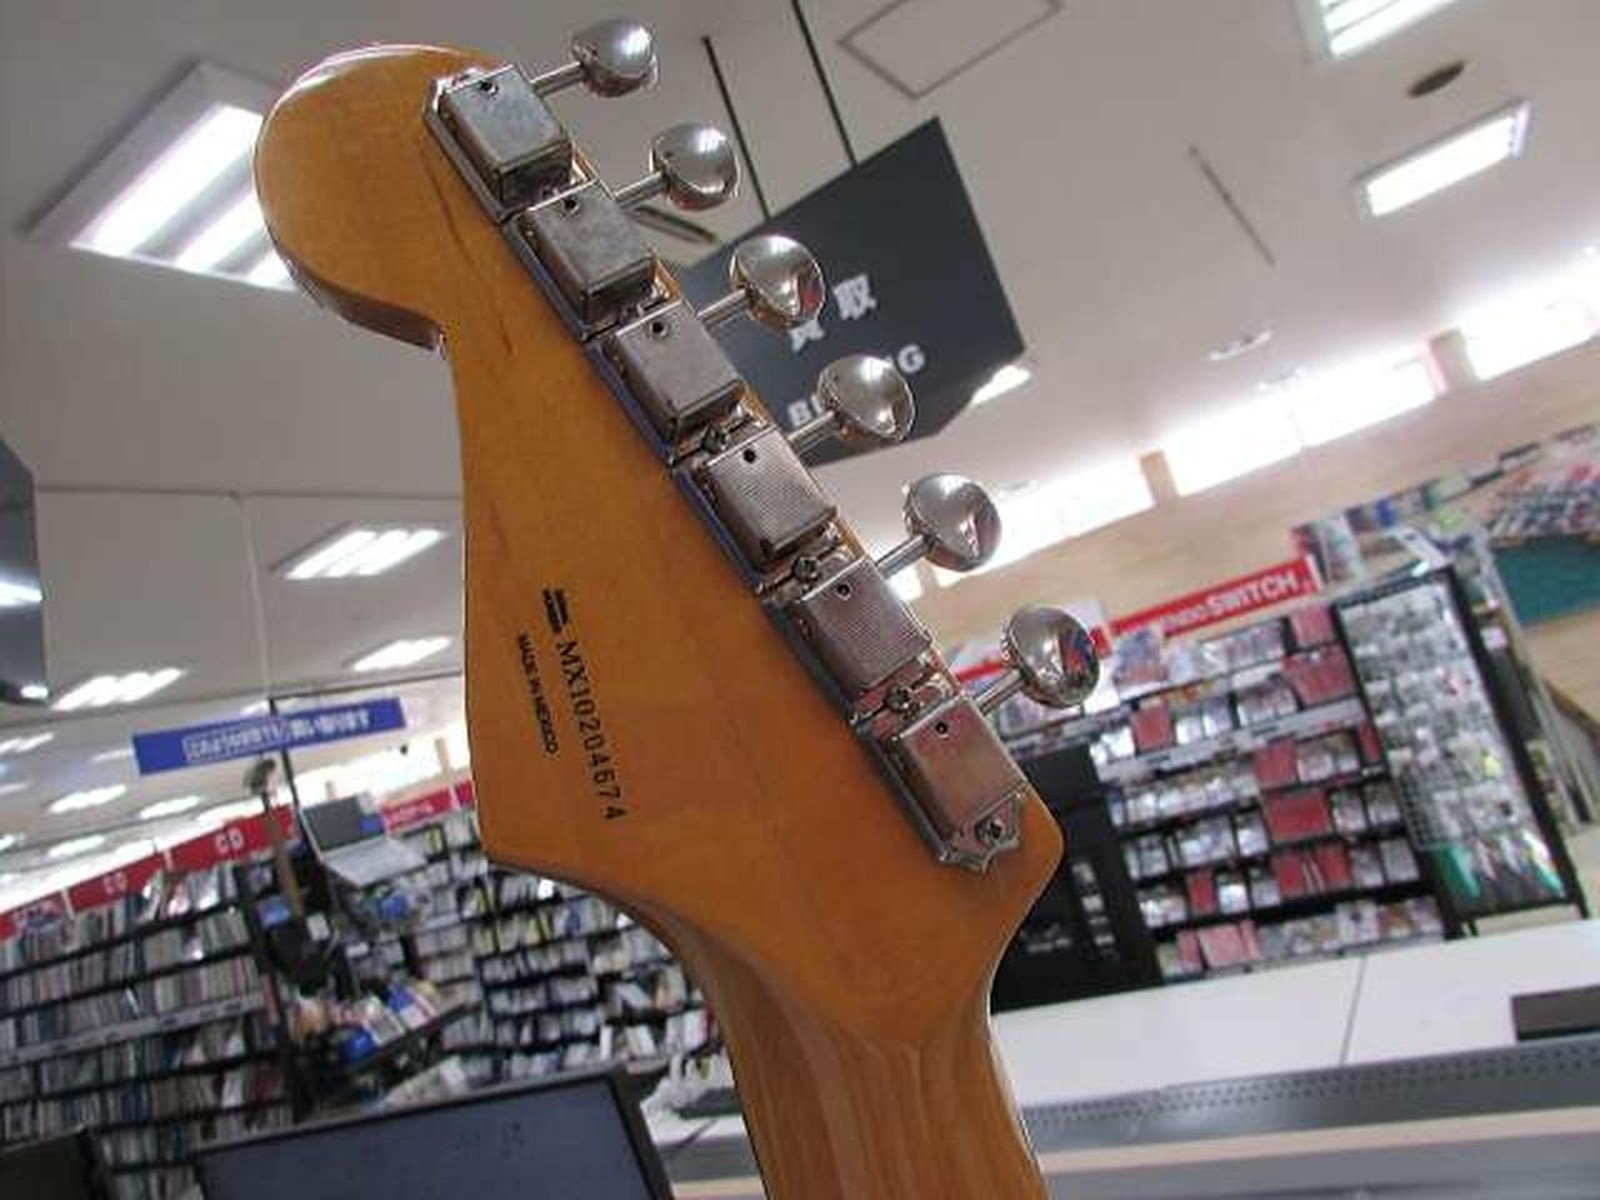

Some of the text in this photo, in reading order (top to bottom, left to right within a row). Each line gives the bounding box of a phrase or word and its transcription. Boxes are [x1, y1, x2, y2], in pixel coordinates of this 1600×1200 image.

[1206, 570, 1299, 616] SWITCH
[529, 677, 541, 696] IN
[535, 696, 559, 754] MEXICO
[216, 827, 244, 855] CD
